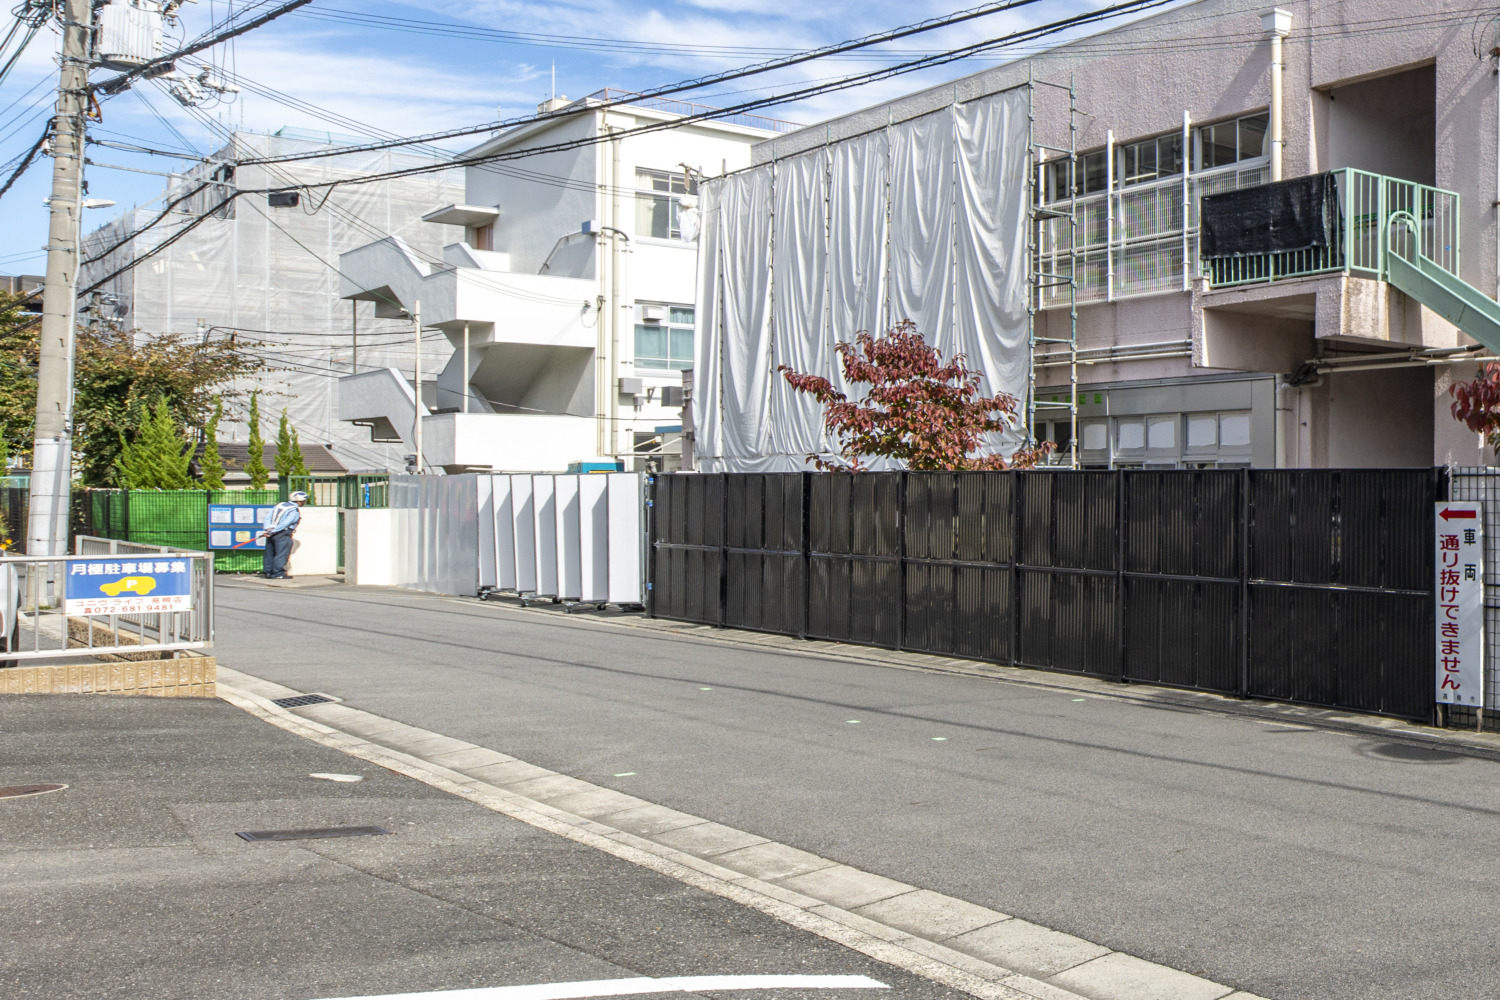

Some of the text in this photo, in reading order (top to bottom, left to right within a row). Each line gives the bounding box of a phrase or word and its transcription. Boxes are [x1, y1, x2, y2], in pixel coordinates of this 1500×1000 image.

[71, 561, 186, 576] 月極駐車場募集
[1463, 528, 1476, 581] 車両
[126, 580, 138, 589] P
[1439, 534, 1461, 690] 通り抜けできません
